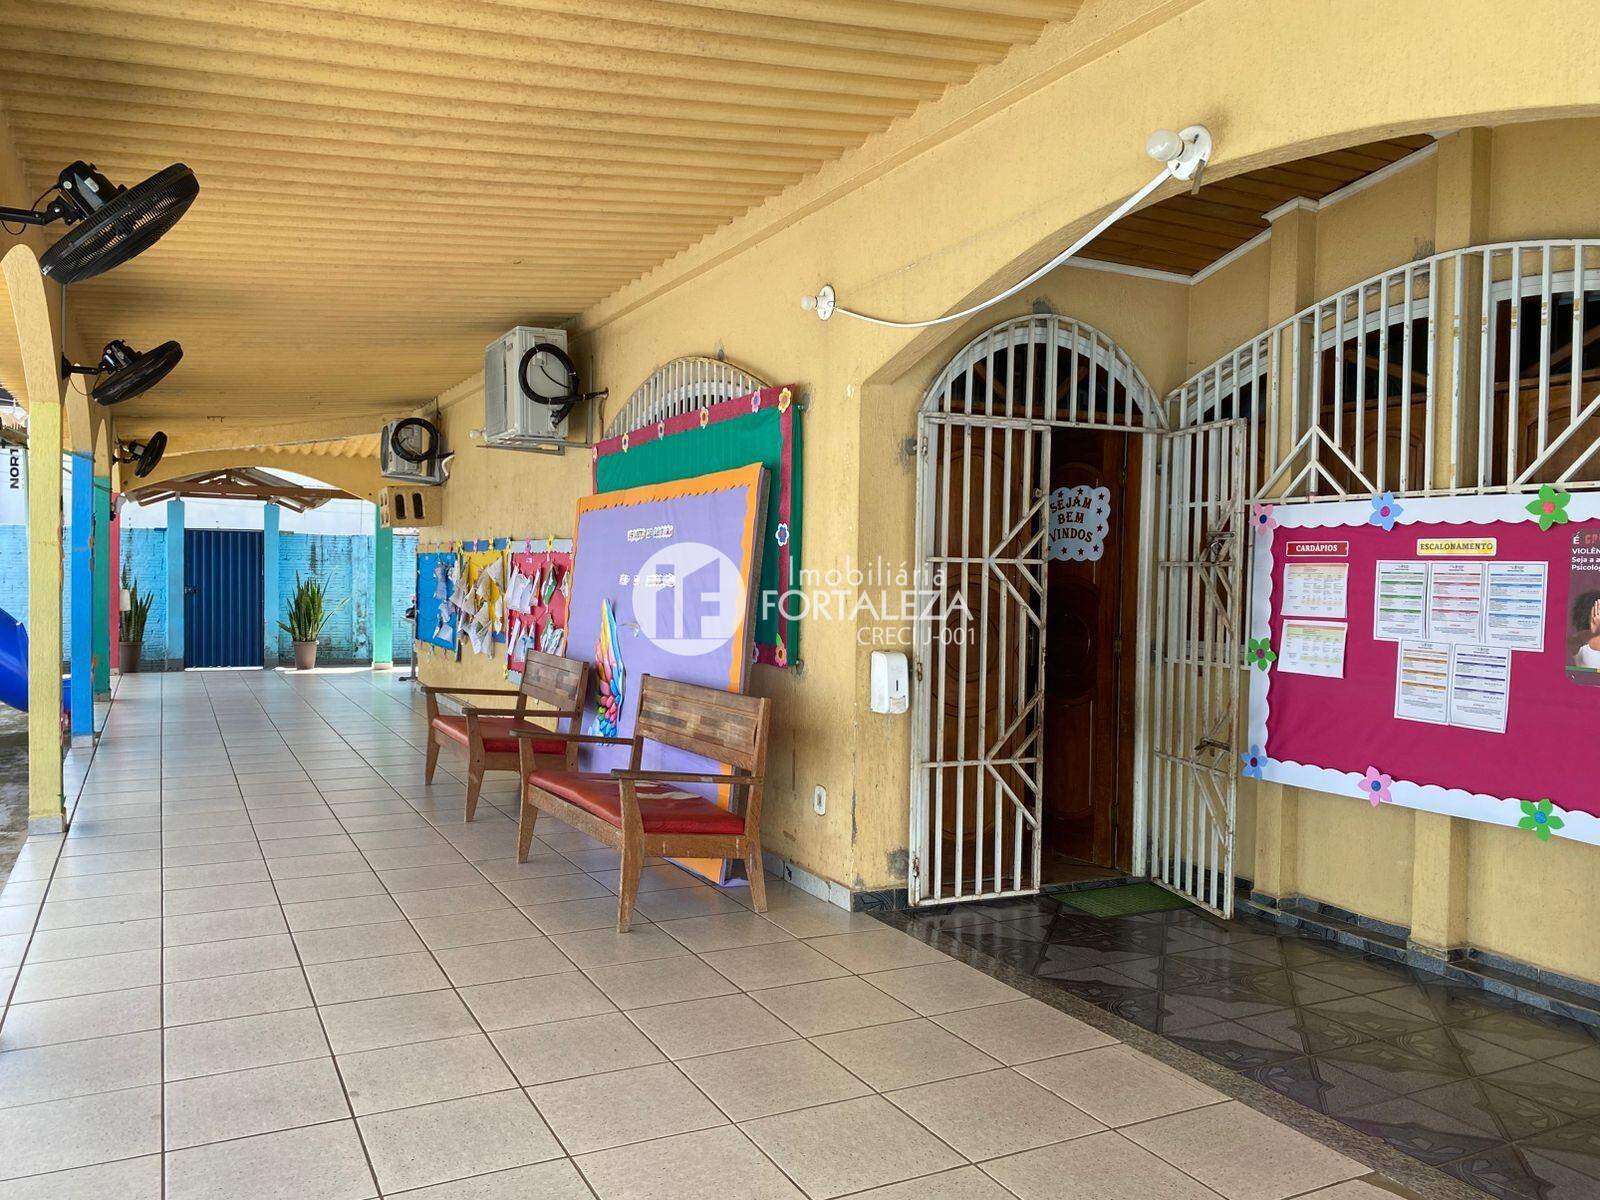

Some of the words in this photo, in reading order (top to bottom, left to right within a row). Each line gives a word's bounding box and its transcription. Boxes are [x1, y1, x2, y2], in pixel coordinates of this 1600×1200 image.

[1050, 496, 1092, 513] SEJAM
[1058, 512, 1084, 524] BEM
[1049, 528, 1093, 542] VINDOS
[1573, 531, 1580, 544] É
[1296, 543, 1338, 552] CARDÁPIOS
[1420, 542, 1494, 550] ESCALONAMENTO
[1572, 556, 1588, 564] Seja
